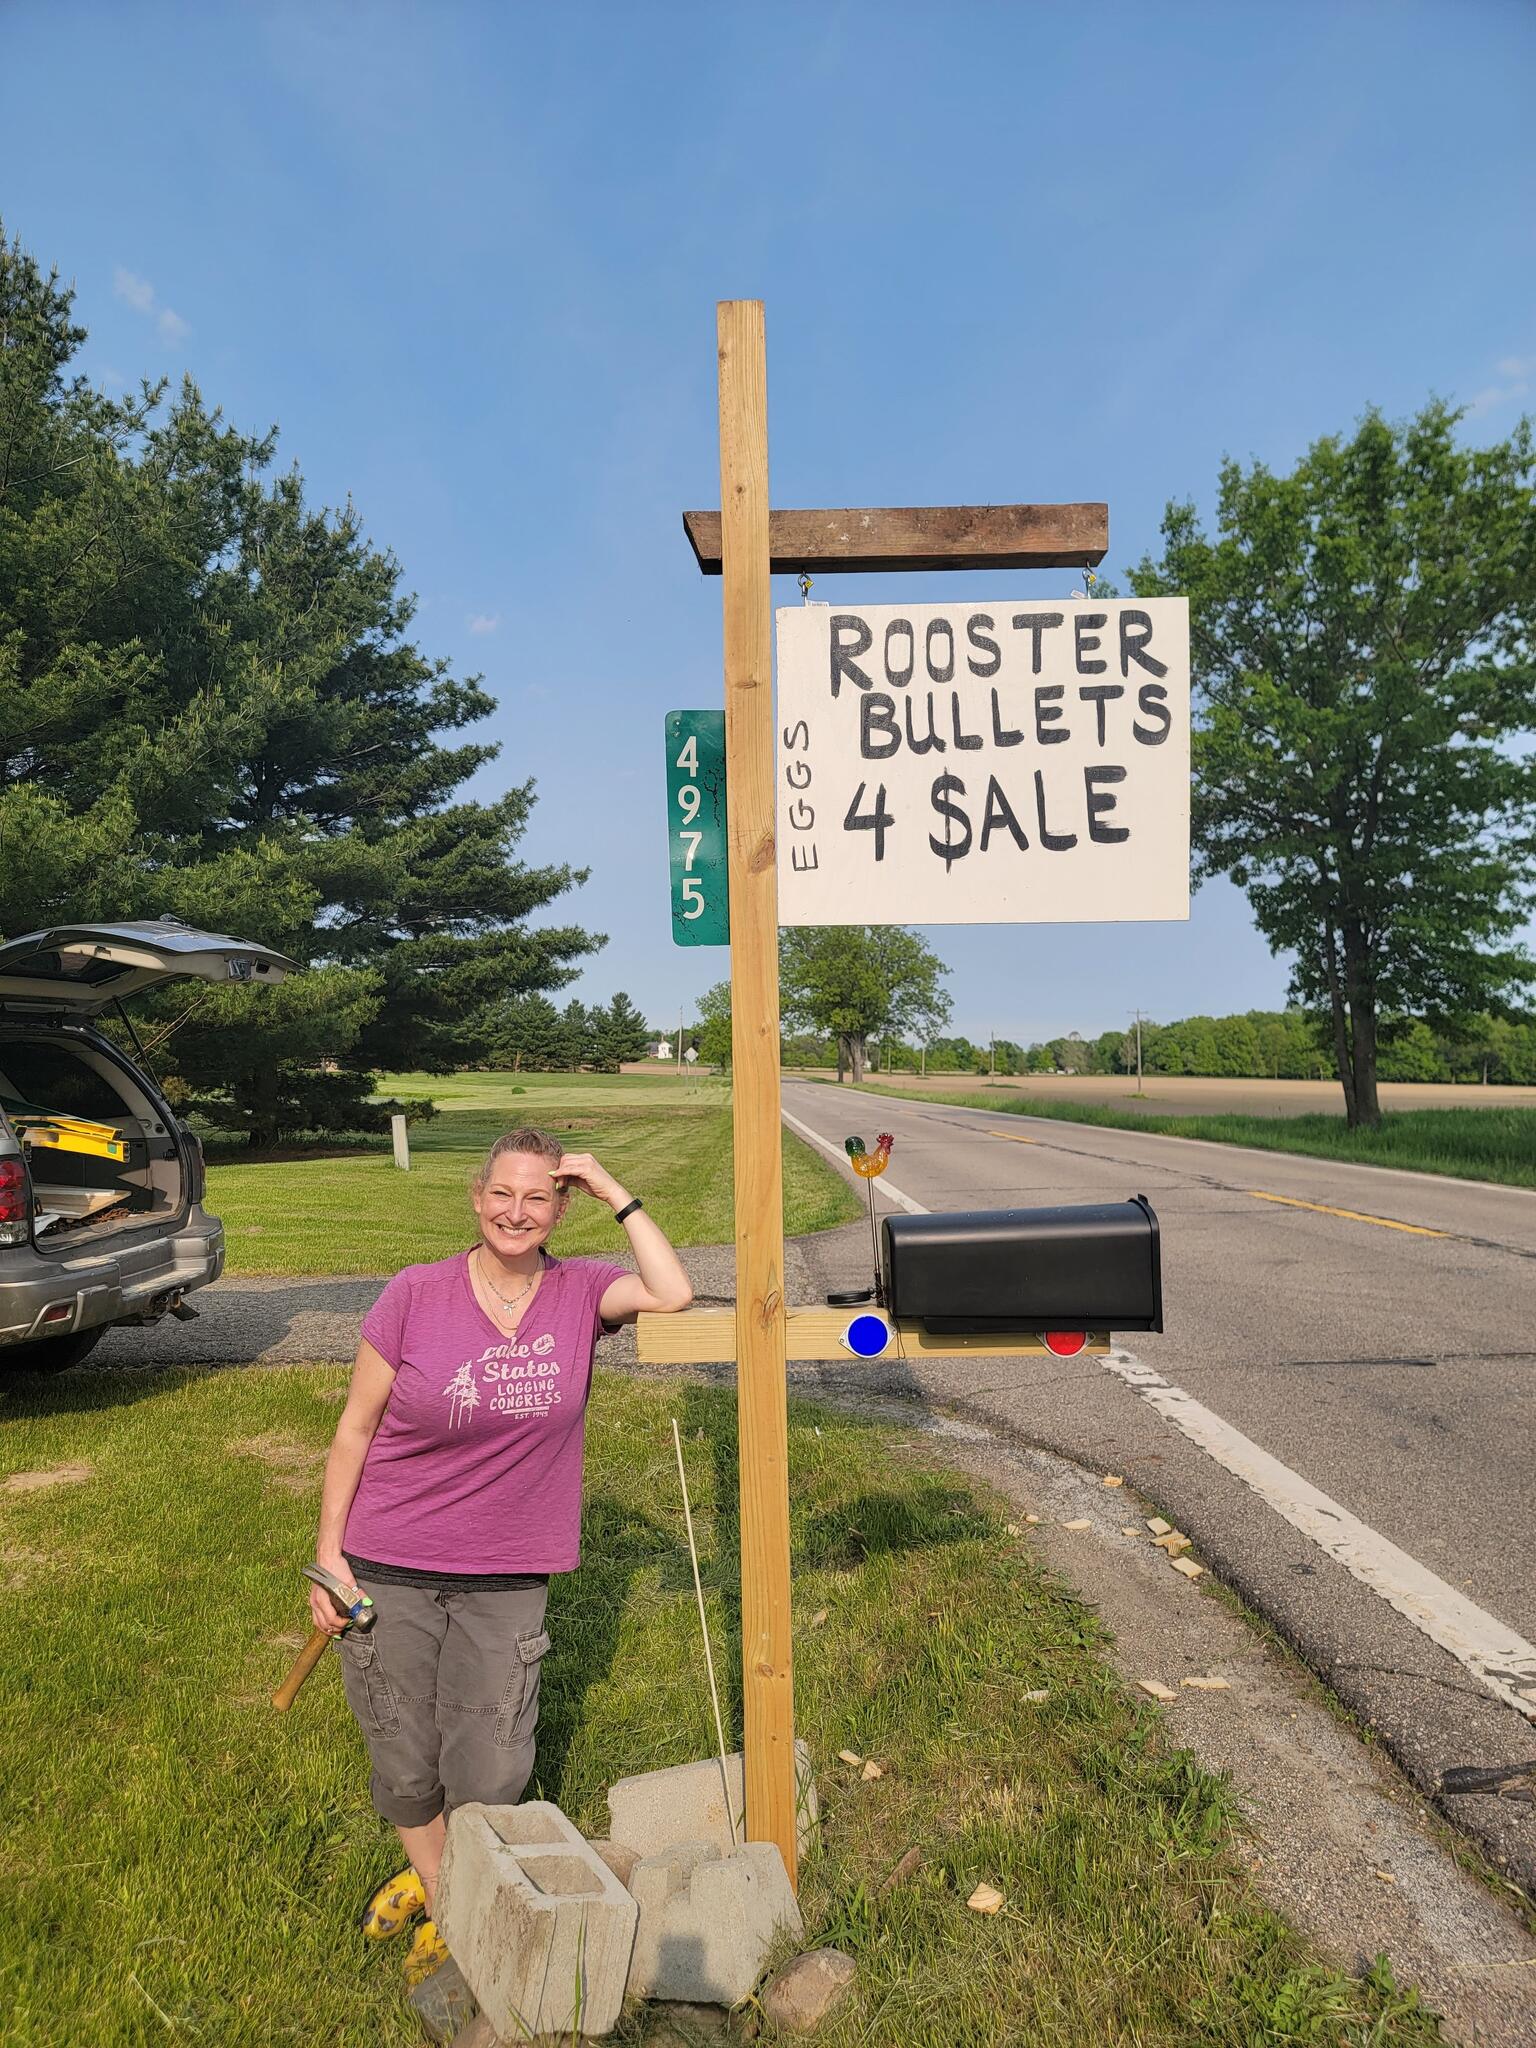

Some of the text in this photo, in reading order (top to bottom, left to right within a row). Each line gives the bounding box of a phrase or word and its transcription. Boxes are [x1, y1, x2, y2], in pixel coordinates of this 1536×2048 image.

[829, 609, 1169, 699] ROOSTER
[860, 683, 1172, 760] BULLETS
[676, 735, 705, 920] 4975
[783, 719, 819, 872] EGGS
[843, 765, 1130, 874] 4 $ALE
[476, 1336, 531, 1362] Lake
[482, 1360, 561, 1383] States
[497, 1378, 556, 1397] LOGGING
[489, 1391, 562, 1411] CONGRESS
